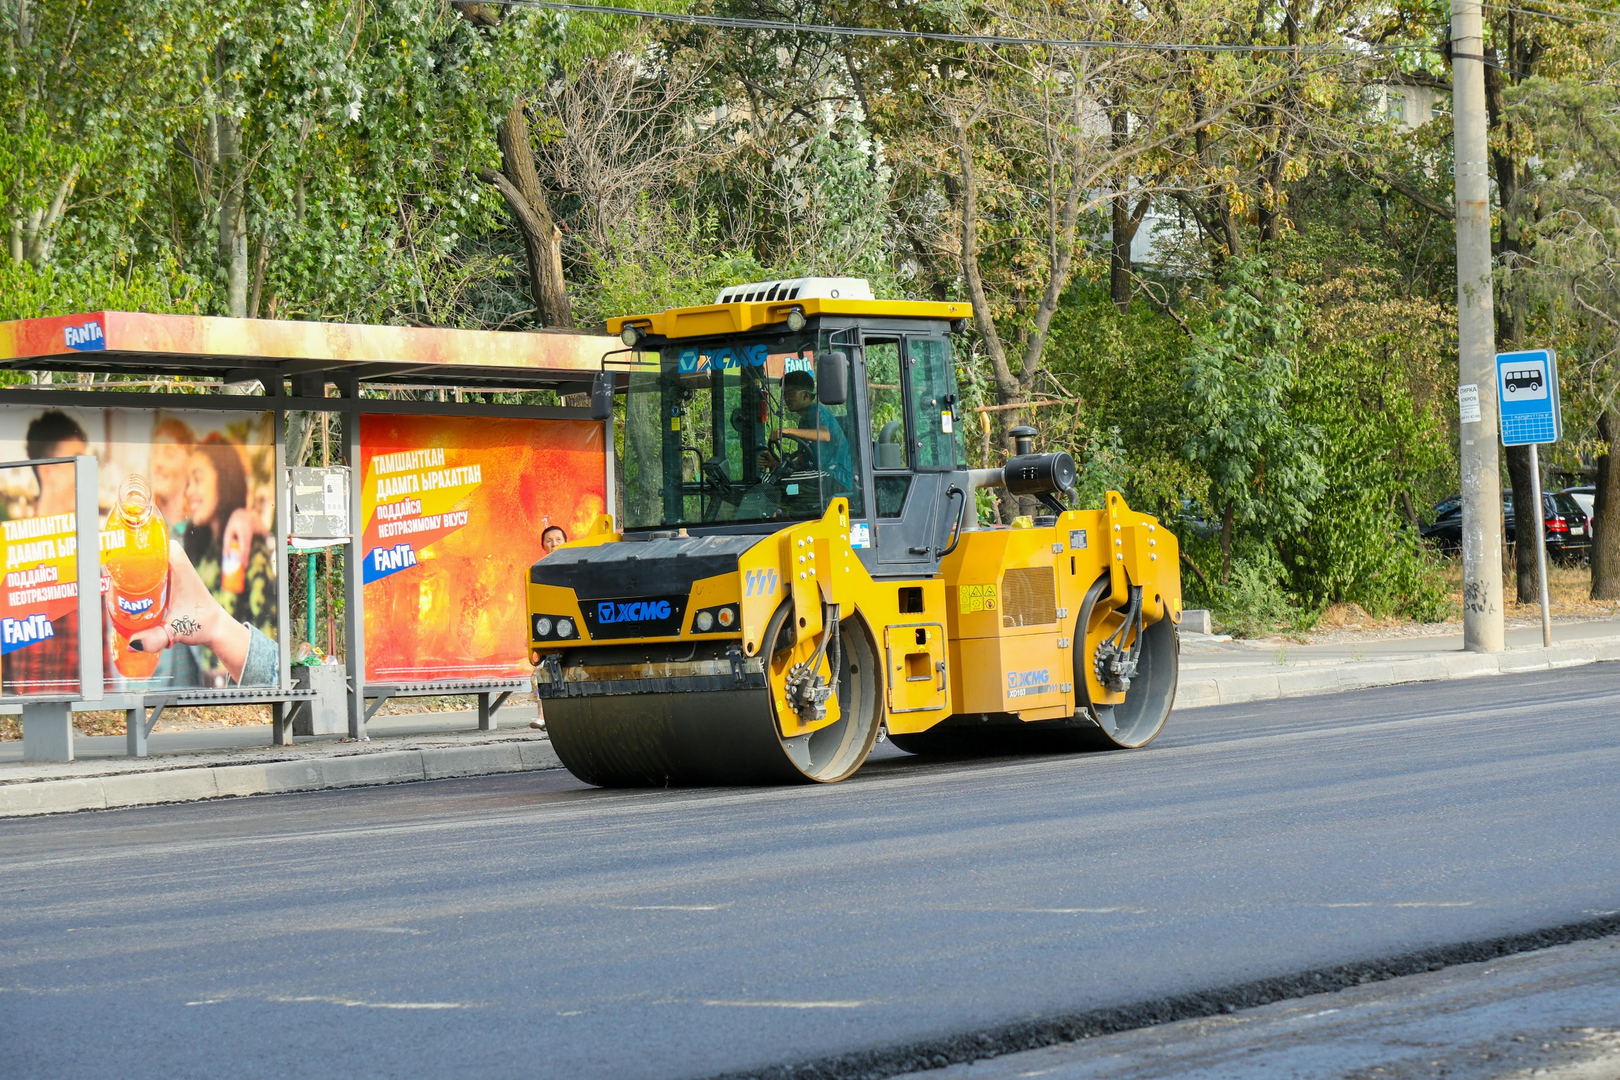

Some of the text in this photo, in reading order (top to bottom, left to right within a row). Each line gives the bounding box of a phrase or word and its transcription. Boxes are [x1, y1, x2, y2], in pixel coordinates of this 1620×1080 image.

[65, 322, 104, 346] FANTA
[699, 344, 768, 372] XCMG
[373, 447, 445, 475] ТАМШАНТКАН
[376, 474, 420, 502] ДААМГА
[421, 464, 482, 491] ЫРАХАТТАН
[376, 497, 422, 521] ПОДДАЙСЯ
[3, 513, 76, 541] ТАМШАНТКА
[378, 510, 469, 539] НЕОТРАЗИМОМУ ВКУСУ
[6, 539, 56, 570] ДААМГА
[374, 544, 417, 571] FANTA
[7, 564, 58, 589] ПОДДАЙСЯ
[8, 582, 78, 607] НЕОТРАЗИМОМУ
[117, 595, 154, 611] FANTA
[615, 600, 671, 623] XCMG
[2, 614, 54, 644] FANTA
[1018, 669, 1049, 687] XCMG
